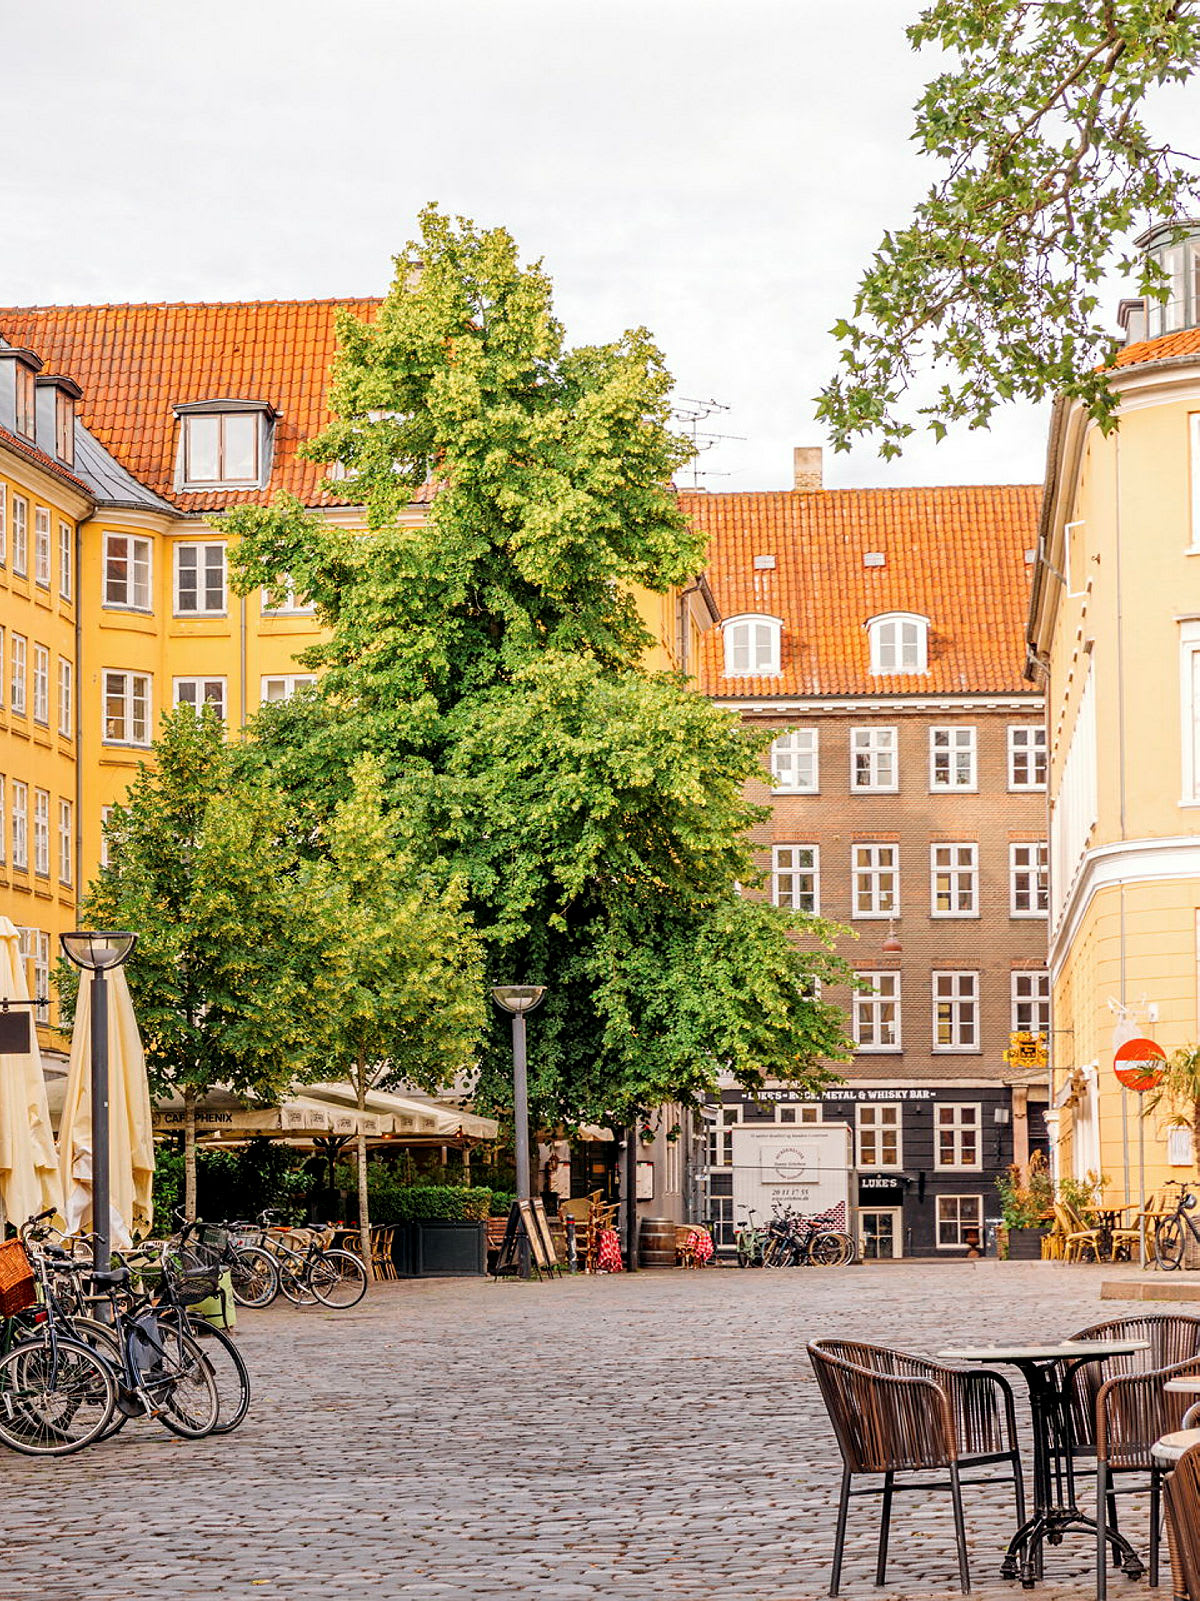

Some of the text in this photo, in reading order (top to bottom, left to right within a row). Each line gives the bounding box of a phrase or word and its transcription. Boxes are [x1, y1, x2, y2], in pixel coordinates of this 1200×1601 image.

[822, 1091, 856, 1100] METAL
[858, 1091, 867, 1100] &
[868, 1091, 907, 1099] WHISKY
[909, 1090, 930, 1099] BAR
[165, 1113, 233, 1123] CAF PHENIX
